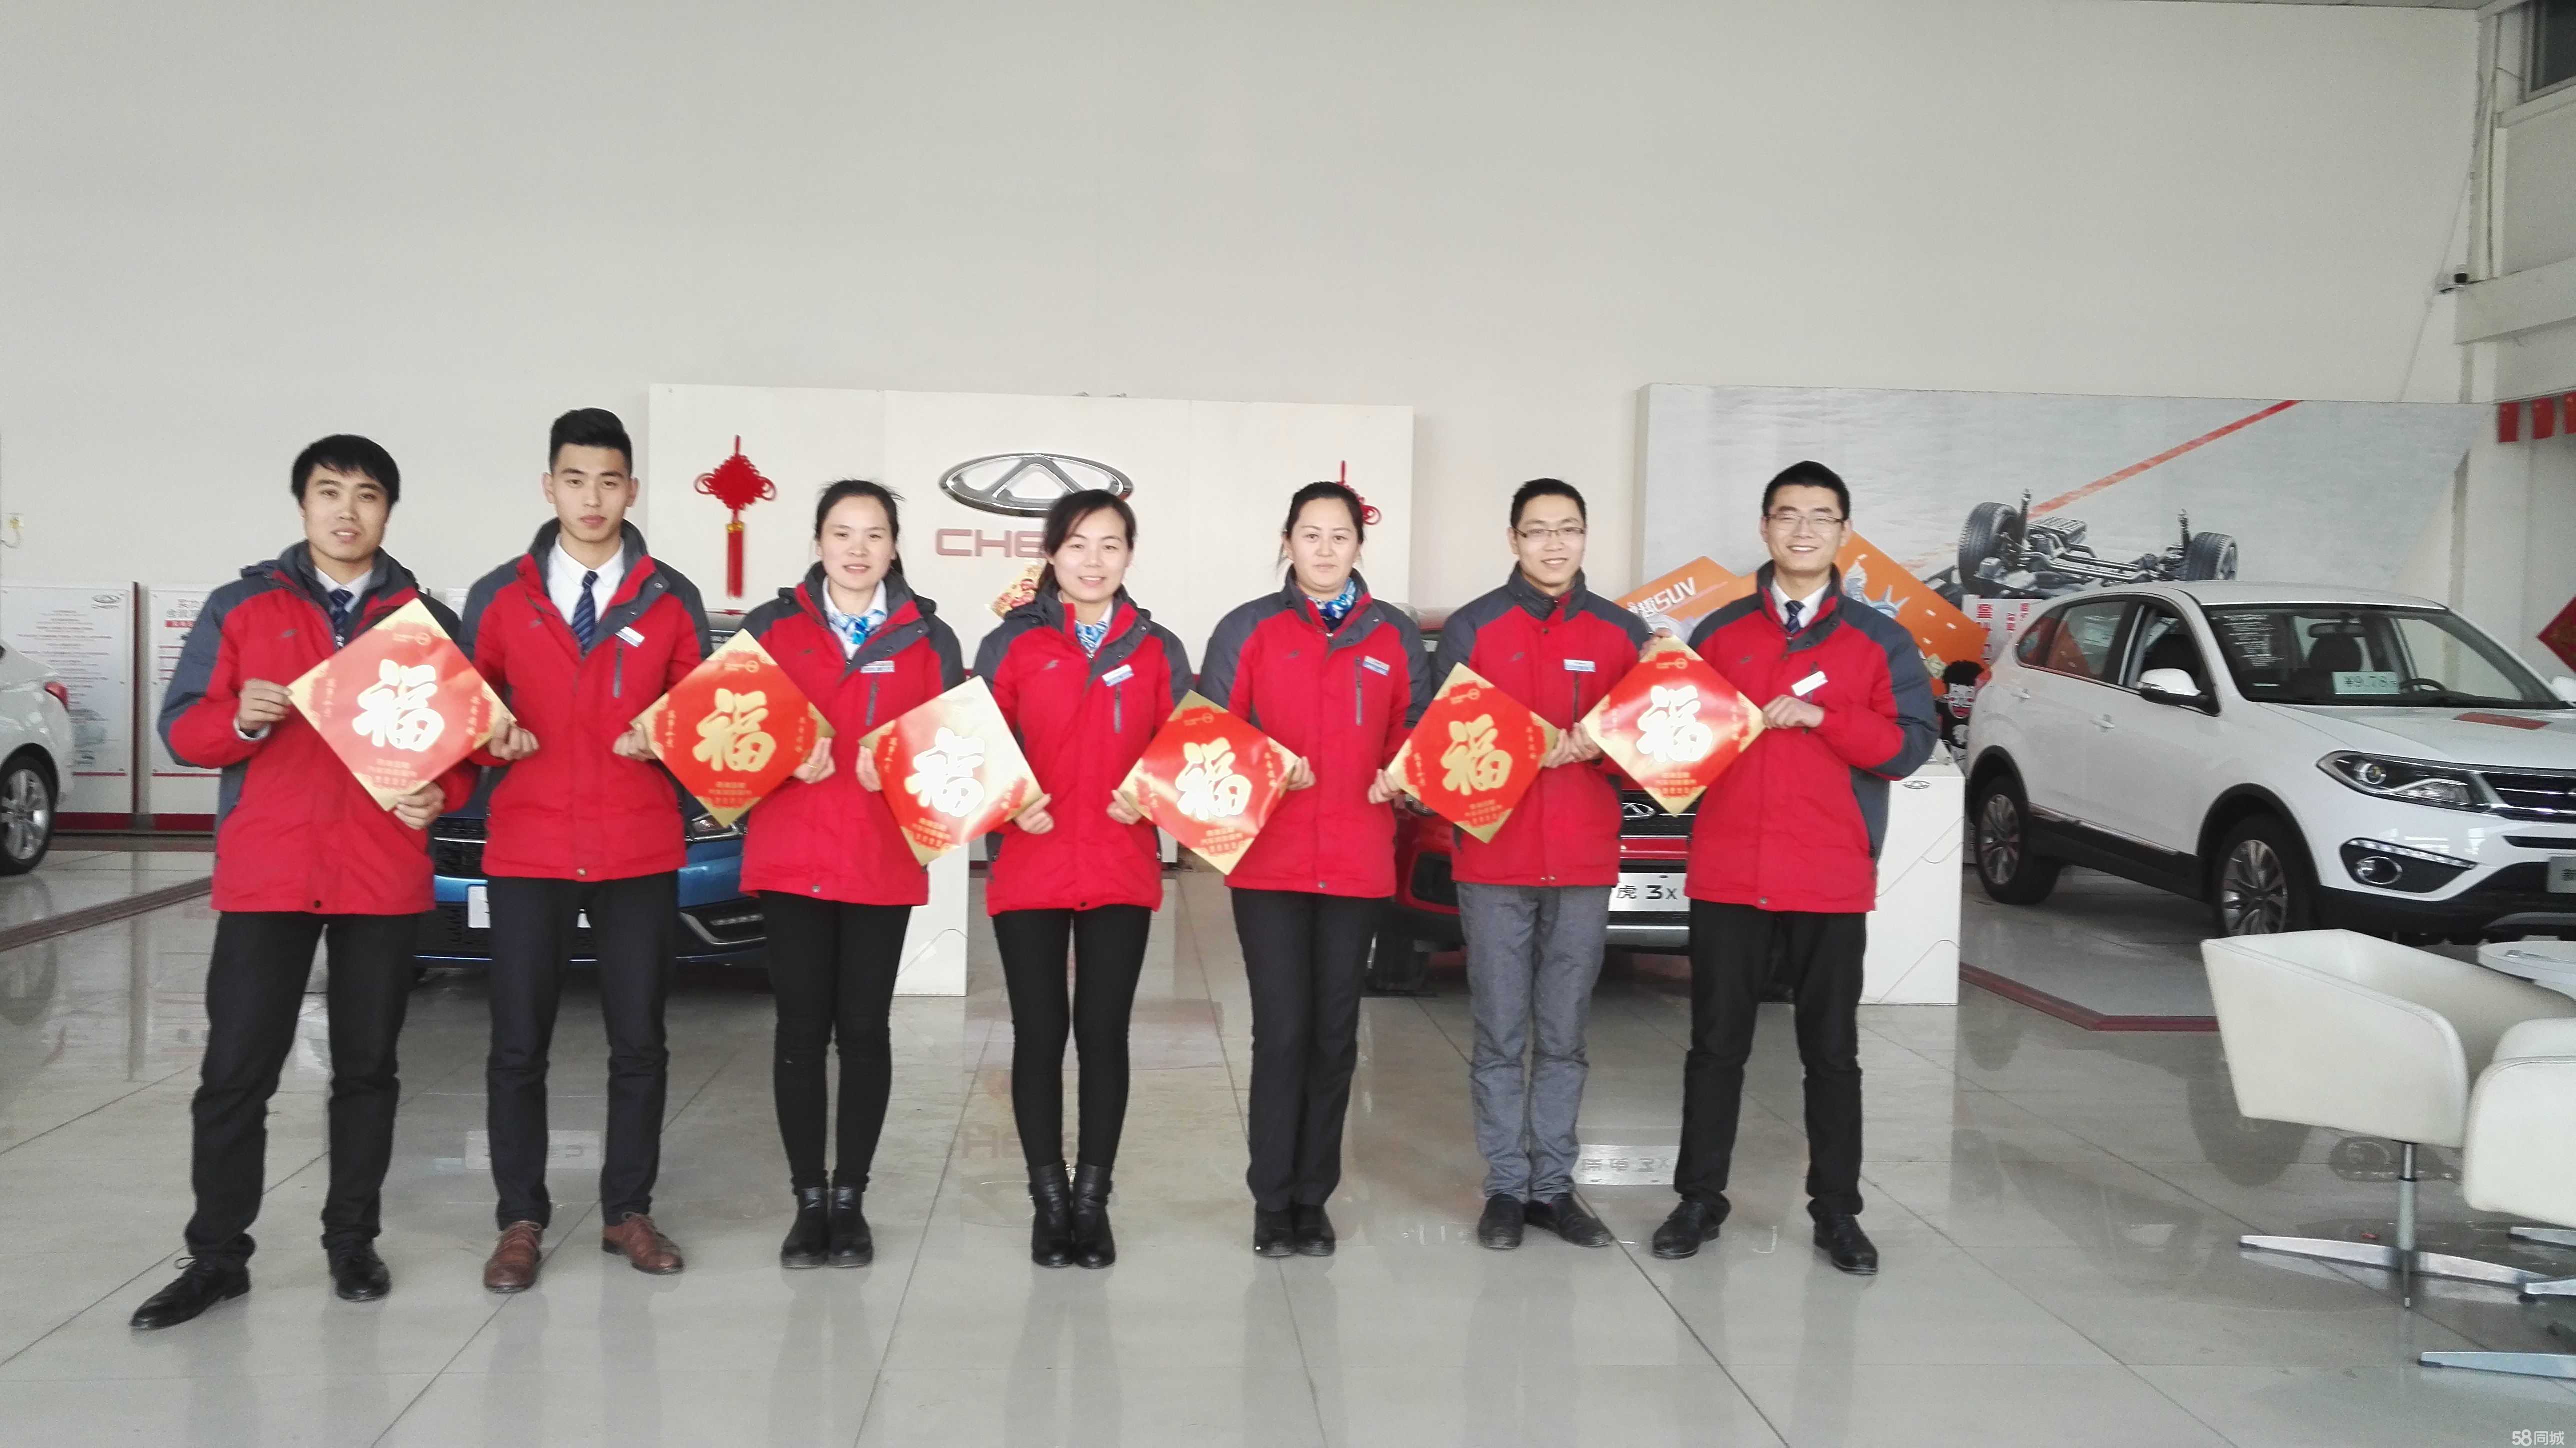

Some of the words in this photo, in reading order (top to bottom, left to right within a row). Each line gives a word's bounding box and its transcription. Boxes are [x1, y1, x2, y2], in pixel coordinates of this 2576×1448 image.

[352, 659, 444, 752] 福
[692, 688, 777, 772] 福
[1636, 685, 1714, 762] 福
[904, 727, 985, 818] 福
[1176, 737, 1253, 821] 福
[1440, 714, 1513, 796] 福
